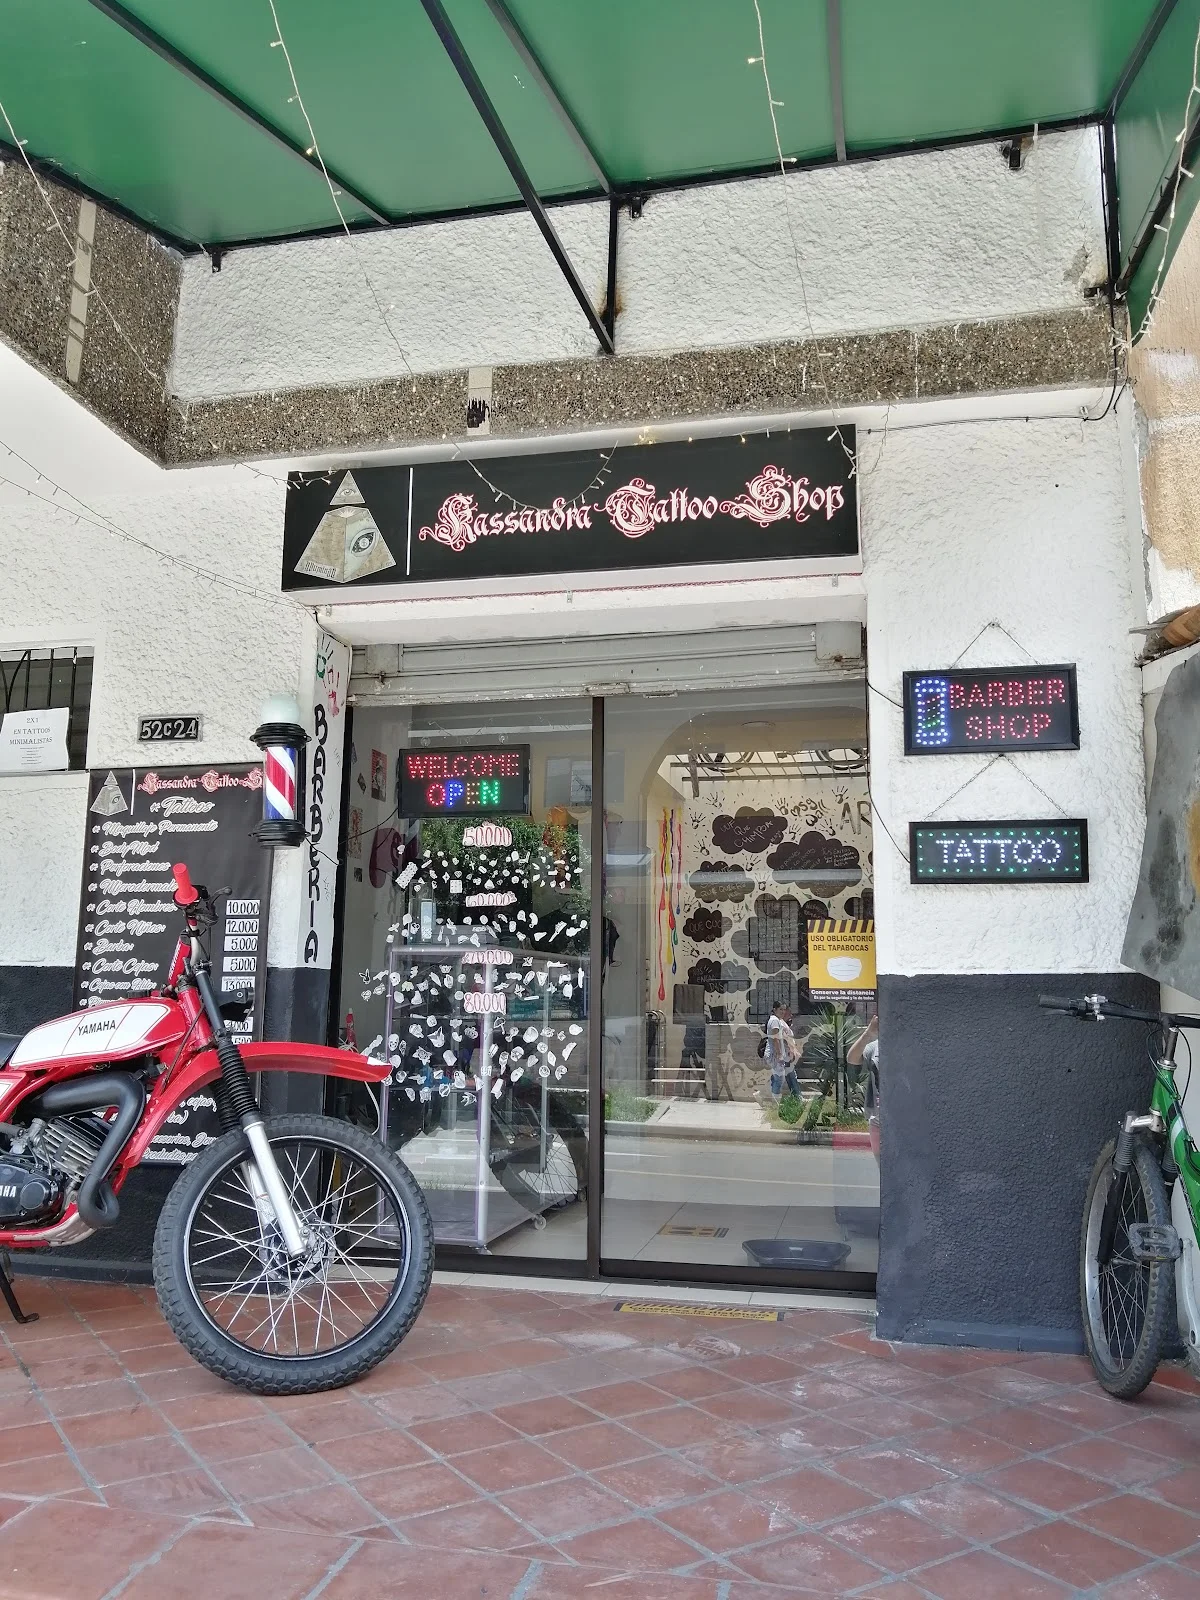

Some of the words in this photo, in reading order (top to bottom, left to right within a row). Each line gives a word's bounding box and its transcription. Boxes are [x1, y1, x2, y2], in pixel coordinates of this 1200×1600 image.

[419, 491, 593, 552] Kassandra
[594, 477, 719, 539] Tattoo
[719, 464, 845, 528] Shop
[950, 678, 1067, 710] BARBER
[965, 712, 1053, 741] SHOP
[9, 736, 53, 746] MINIMALISTAS
[407, 753, 520, 779] WELCOME
[198, 769, 240, 793] Tattoo
[427, 780, 500, 806] OPEN
[161, 796, 216, 818] Tattoos
[102, 821, 158, 838] Maquillaje
[158, 819, 219, 836] Permanente
[98, 841, 130, 858] Body
[128, 840, 161, 856] Mod
[935, 838, 1063, 865] TATTOO
[100, 859, 171, 877] Perforaciones
[99, 878, 178, 896] Microdermale
[95, 899, 127, 916] Corte
[227, 901, 260, 914] 10.000
[94, 919, 126, 937] Corte
[226, 919, 258, 933] 12.000
[231, 937, 257, 951] 5.000
[828, 944, 869, 952] TAPABOCAS
[91, 957, 124, 975] Corte
[464, 992, 507, 1013] 80.000
[78, 1019, 116, 1036] YAMAHA
